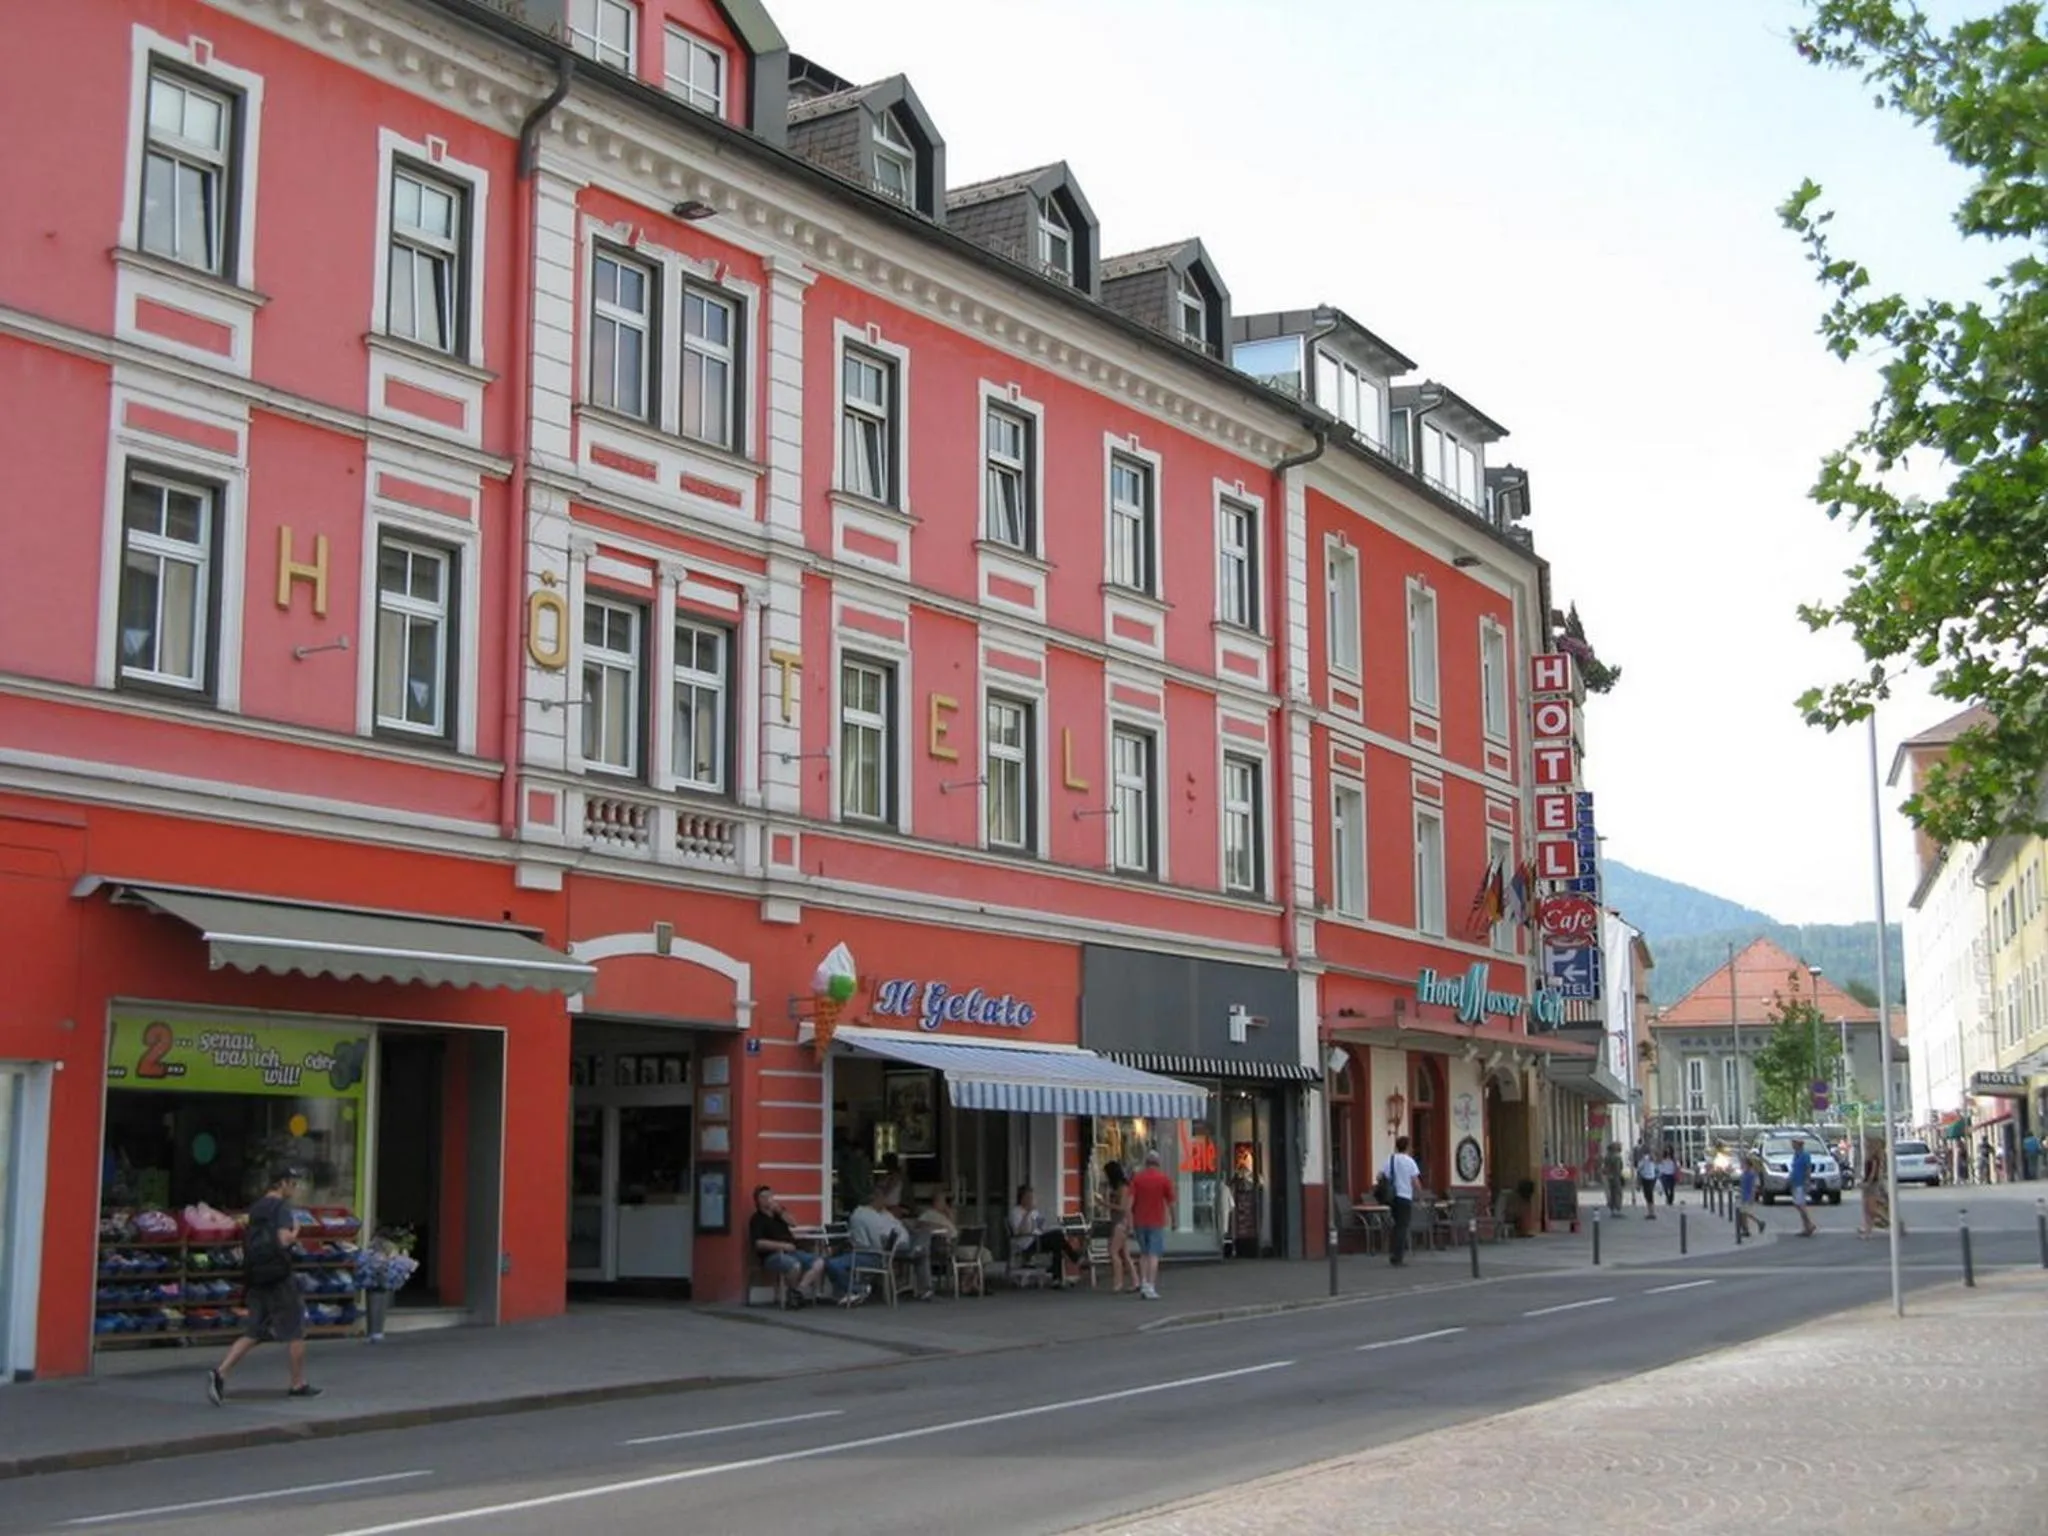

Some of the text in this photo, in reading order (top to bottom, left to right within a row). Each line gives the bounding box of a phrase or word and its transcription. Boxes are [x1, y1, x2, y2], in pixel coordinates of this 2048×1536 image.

[1535, 658, 1568, 875] HOTEL
[1543, 908, 1592, 934] Cafe
[1419, 968, 1466, 1007] Hotel
[873, 979, 1036, 1031] Il Gelato
[199, 1032, 254, 1052] genau
[213, 1048, 280, 1068] was ich
[304, 1052, 337, 1071] oder
[264, 1066, 301, 1086] will!
[1979, 1071, 2026, 1087] HOTEL
[1177, 1117, 1219, 1174] Sale
